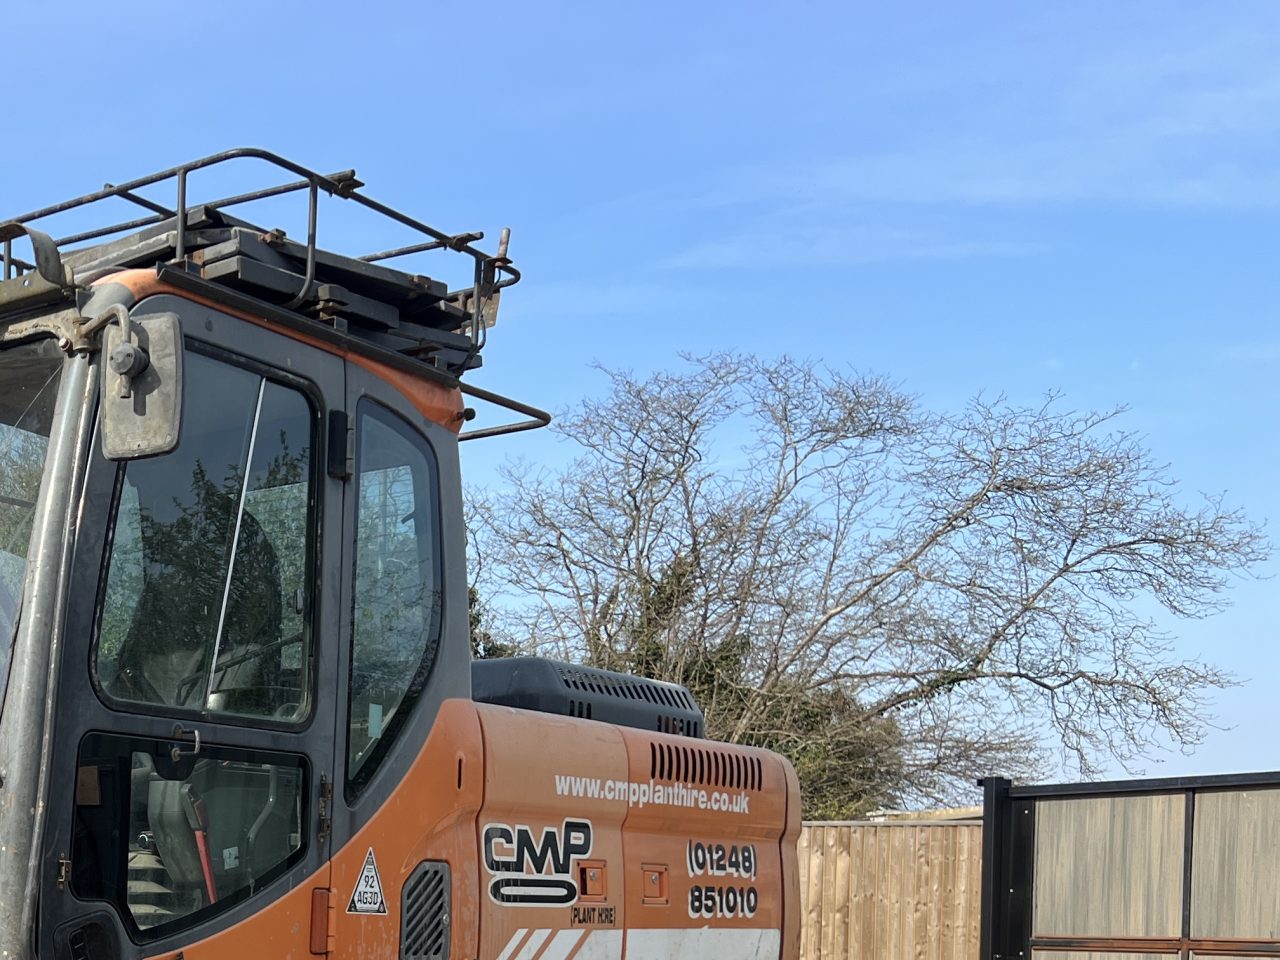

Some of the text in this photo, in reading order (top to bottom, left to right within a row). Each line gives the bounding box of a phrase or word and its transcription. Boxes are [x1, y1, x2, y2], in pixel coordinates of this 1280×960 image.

[554, 775, 750, 814] www.cmpplanthire.co.uk
[483, 818, 592, 876] CMP
[686, 839, 757, 881] (01248)
[364, 875, 375, 889] 92
[688, 885, 758, 919] 851010
